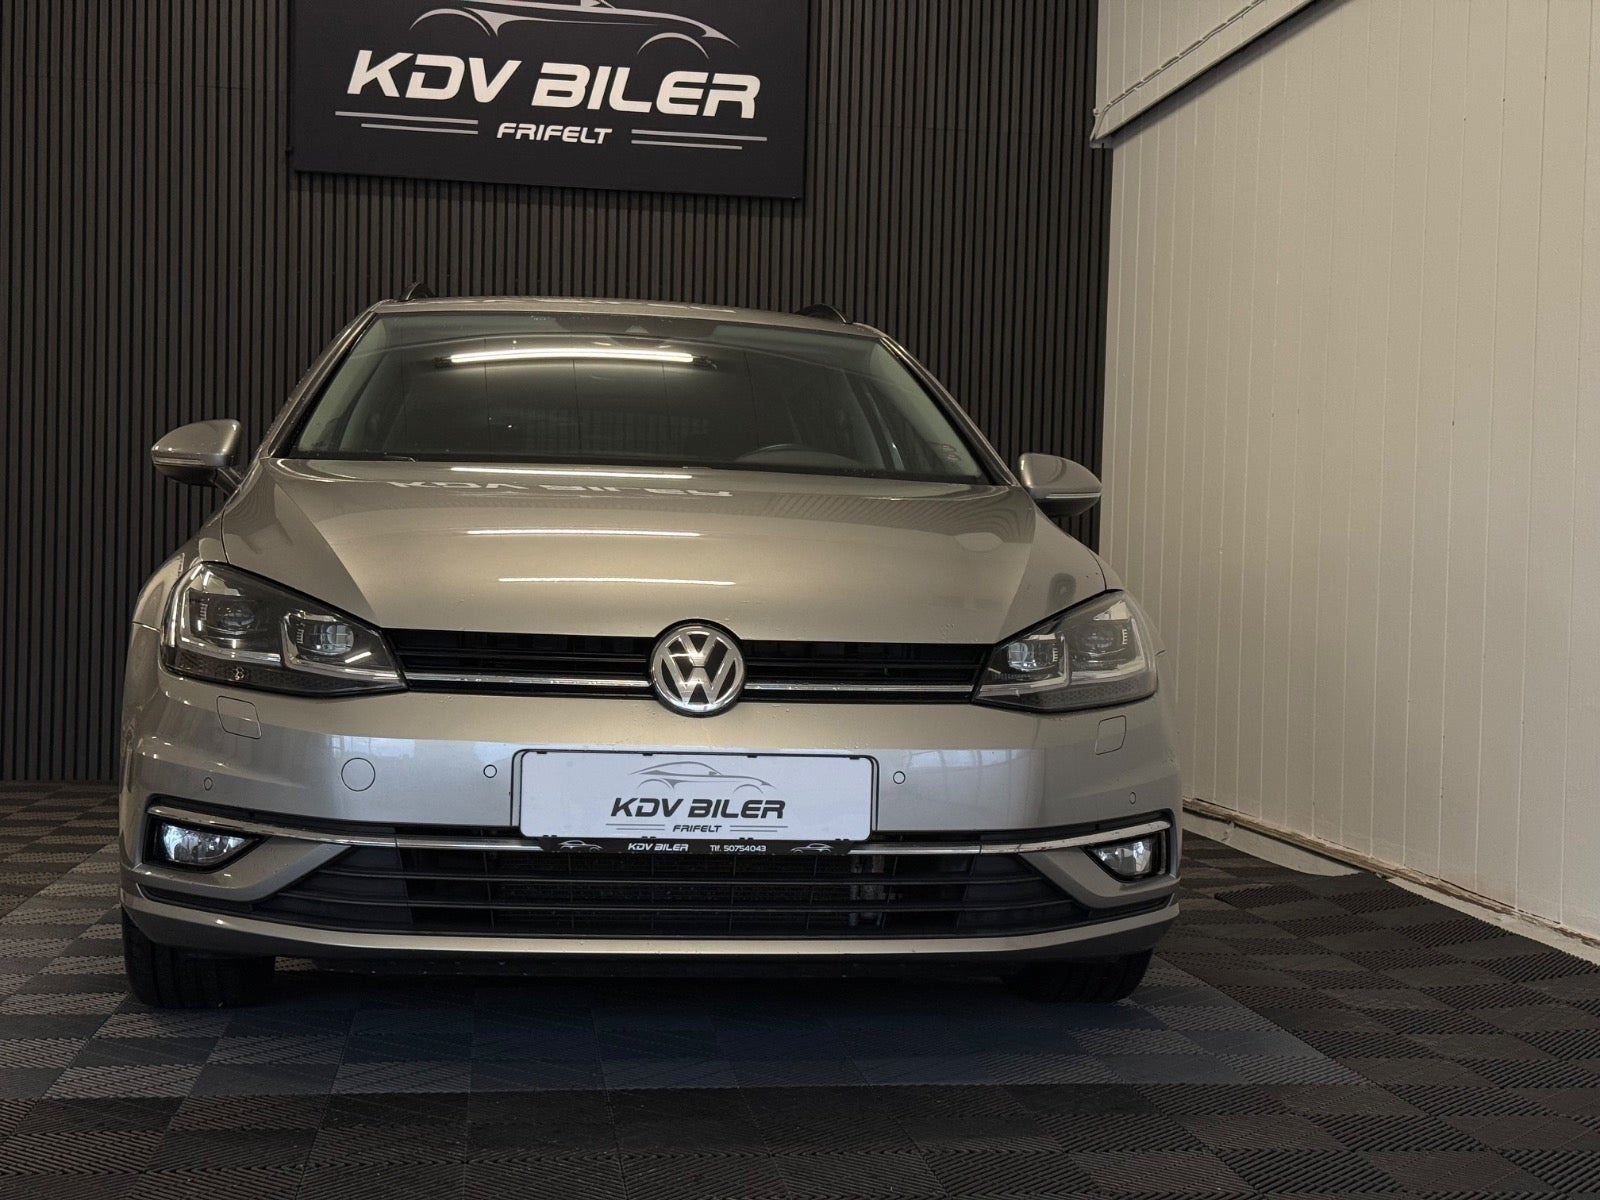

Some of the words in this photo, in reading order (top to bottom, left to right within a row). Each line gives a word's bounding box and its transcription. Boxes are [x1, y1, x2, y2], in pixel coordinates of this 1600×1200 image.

[347, 49, 522, 103] KDV
[531, 62, 761, 119] BILER
[496, 122, 613, 145] FRIFELT
[653, 624, 744, 712] VW
[610, 797, 684, 818] KDV
[688, 798, 786, 819] BILER
[672, 824, 723, 833] FRIFELT
[627, 842, 654, 851] KDV
[655, 843, 689, 852] BILER
[723, 844, 767, 853] 50754043
